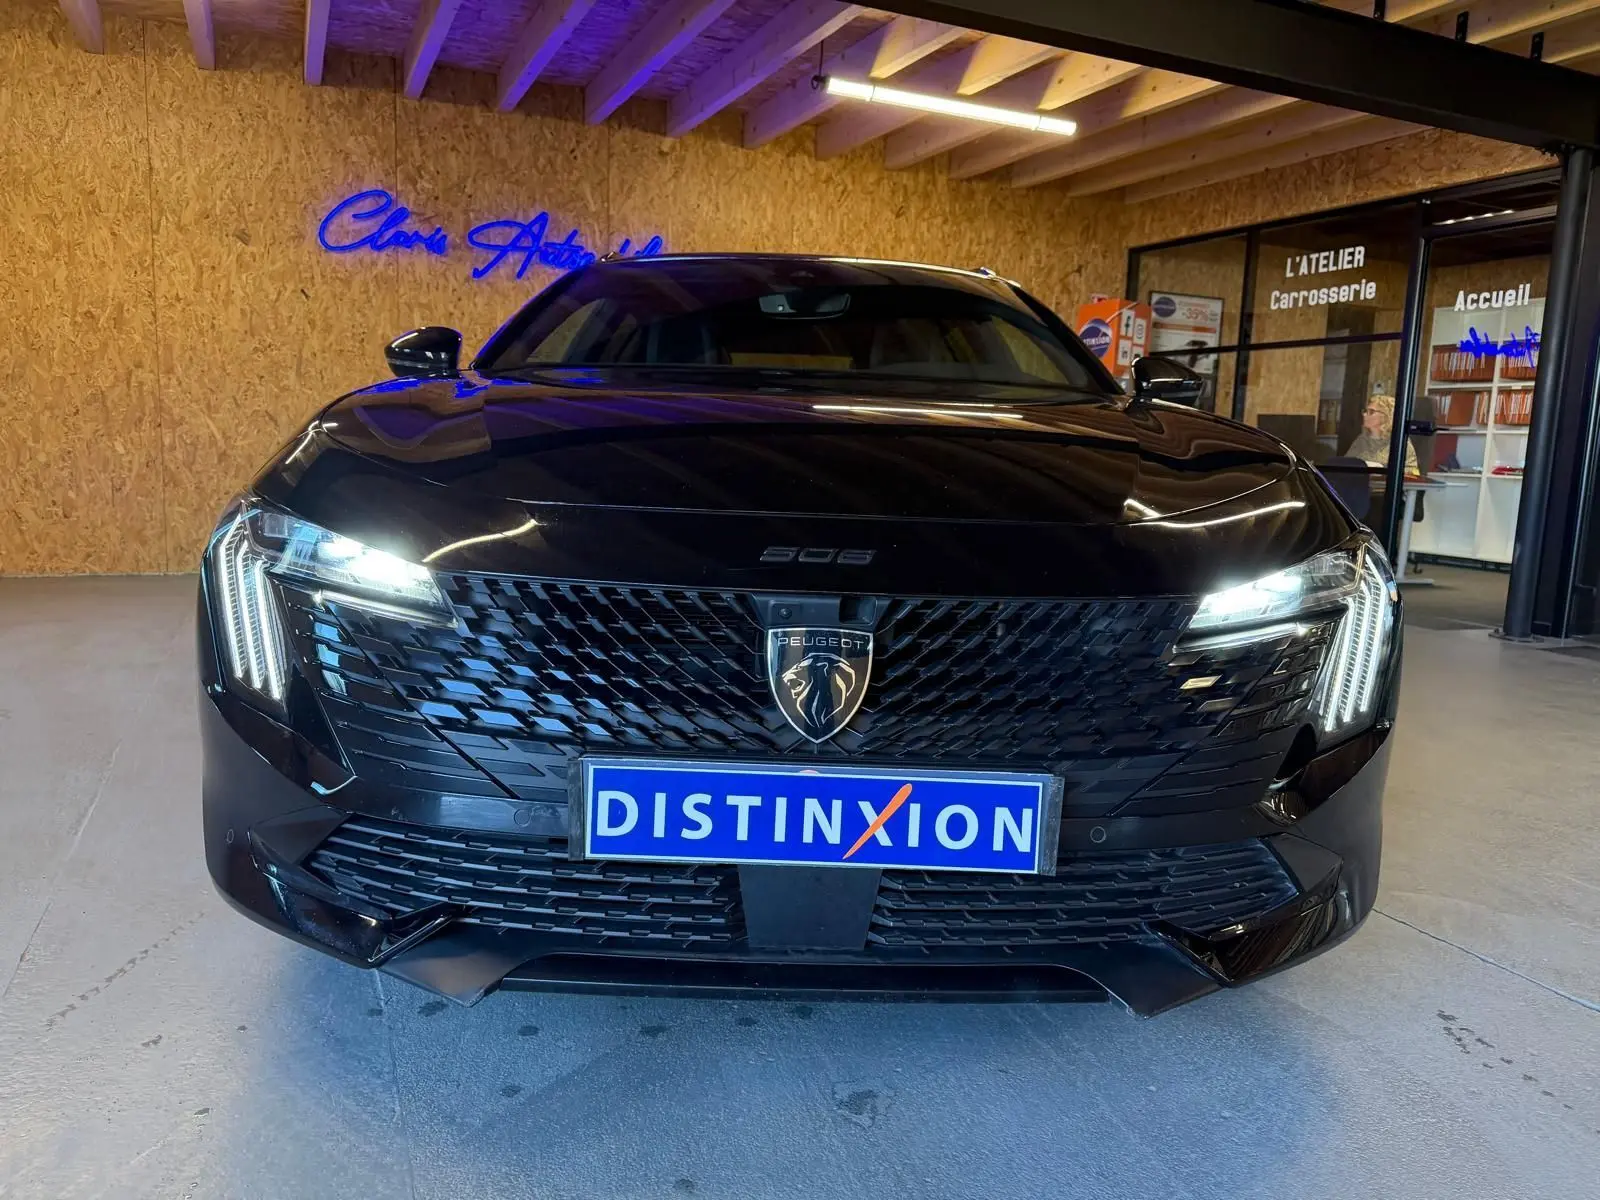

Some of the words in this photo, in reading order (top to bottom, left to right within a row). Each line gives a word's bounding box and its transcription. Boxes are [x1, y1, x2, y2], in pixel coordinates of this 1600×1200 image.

[1285, 245, 1365, 278] L'ATELIER
[1270, 278, 1377, 310] Carrosserie
[1454, 283, 1531, 311] Accueil
[777, 636, 865, 649] PEUGEOT
[596, 783, 1033, 860] DISTINXION
